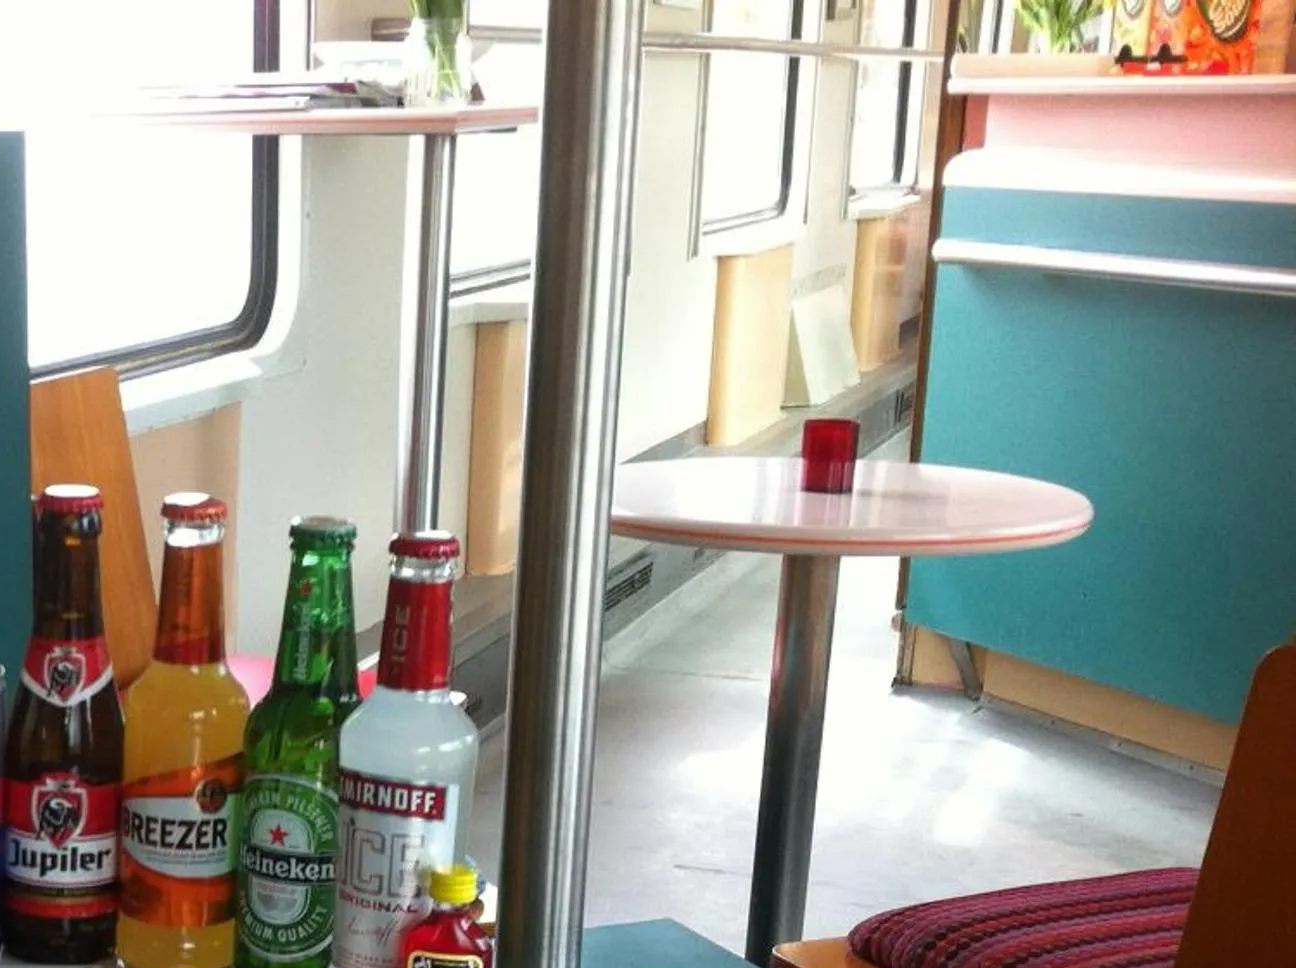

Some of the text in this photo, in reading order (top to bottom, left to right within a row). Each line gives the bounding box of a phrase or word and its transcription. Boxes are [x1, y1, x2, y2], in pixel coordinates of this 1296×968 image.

[124, 808, 228, 849] BREEZER
[9, 838, 111, 877] Jupiler
[277, 903, 329, 943] QUALITY
